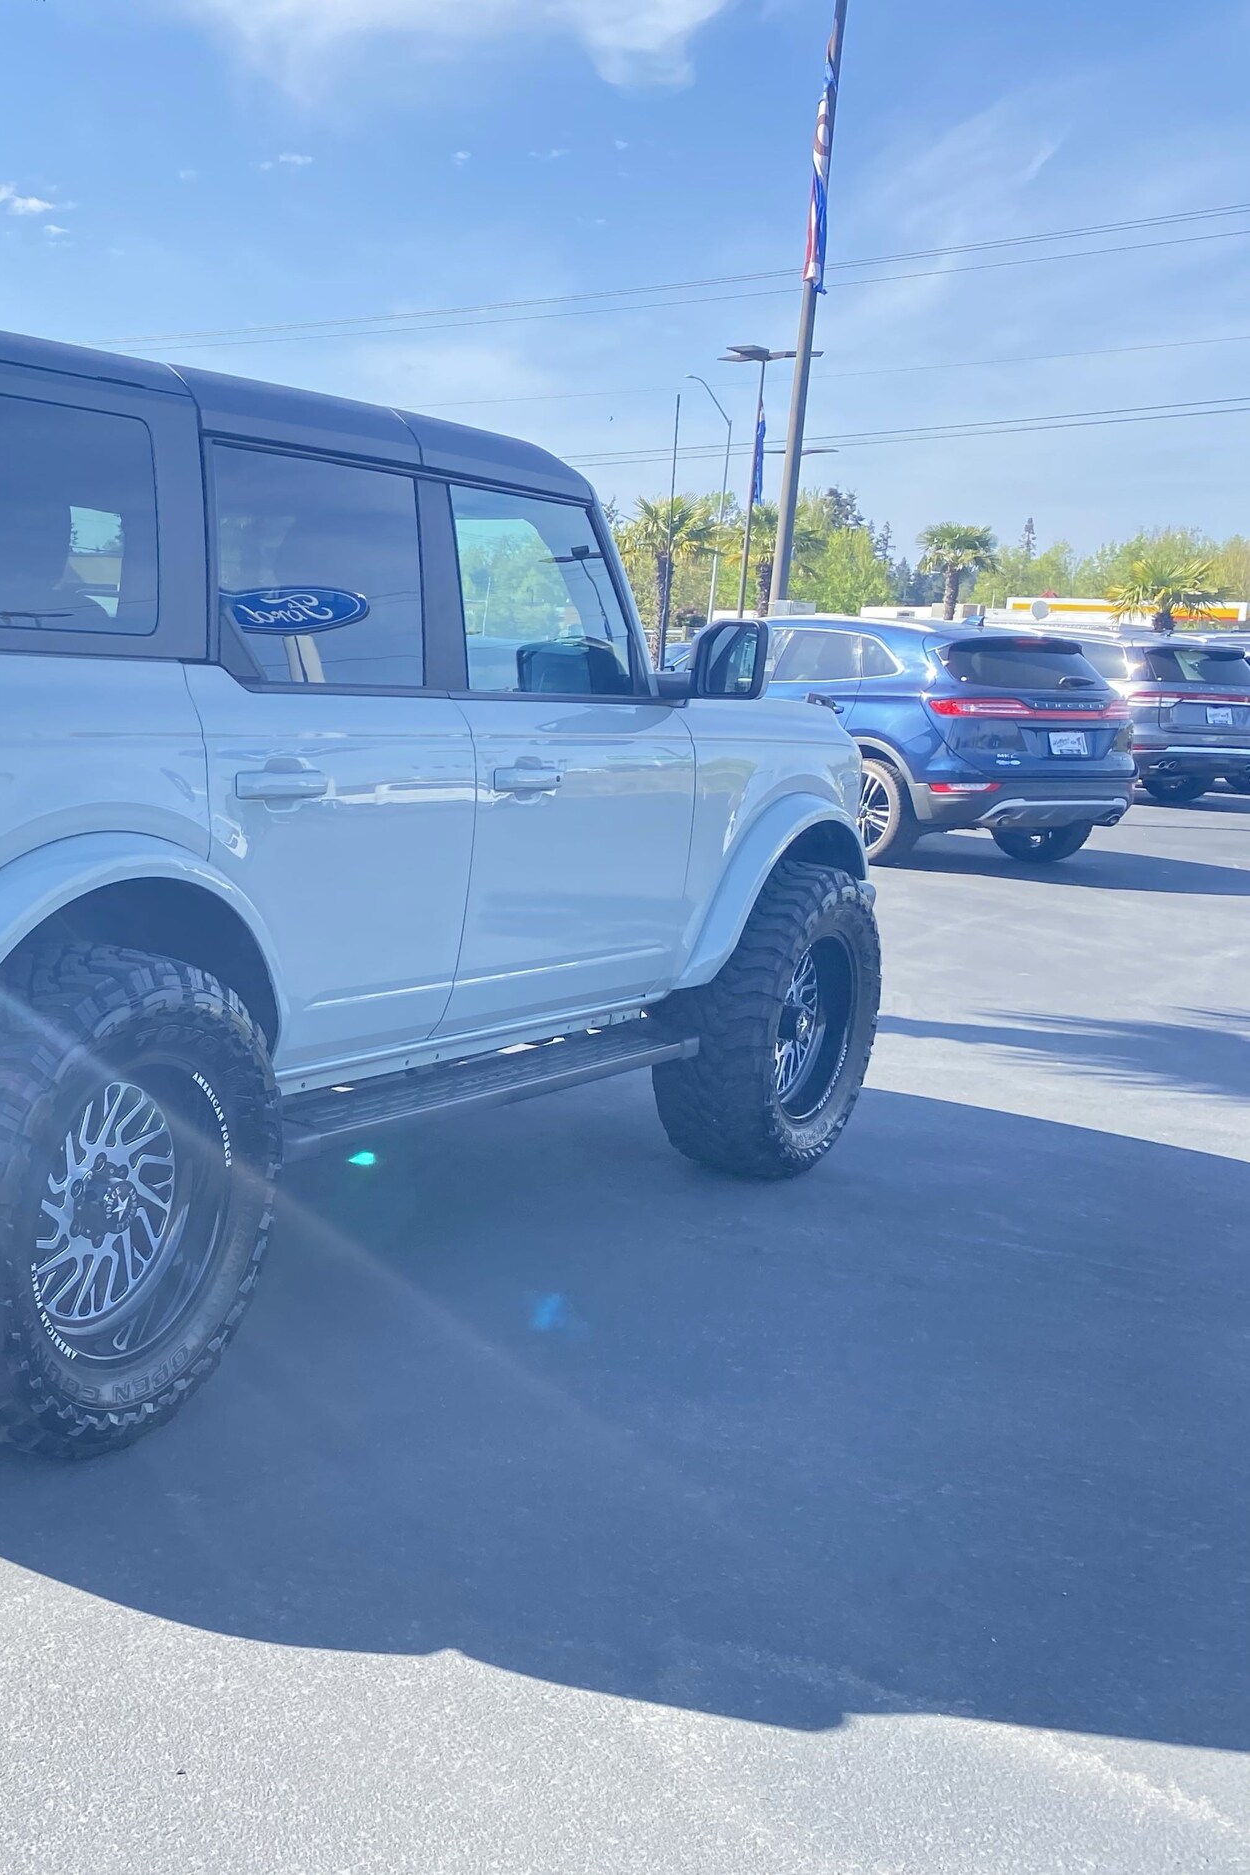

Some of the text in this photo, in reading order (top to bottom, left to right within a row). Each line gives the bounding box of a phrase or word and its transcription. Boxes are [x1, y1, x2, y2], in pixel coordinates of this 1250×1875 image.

[191, 1071, 233, 1168] AMERICAN FORCE
[39, 1311, 79, 1361] AMERICAN
[112, 1342, 193, 1403] OPEN
